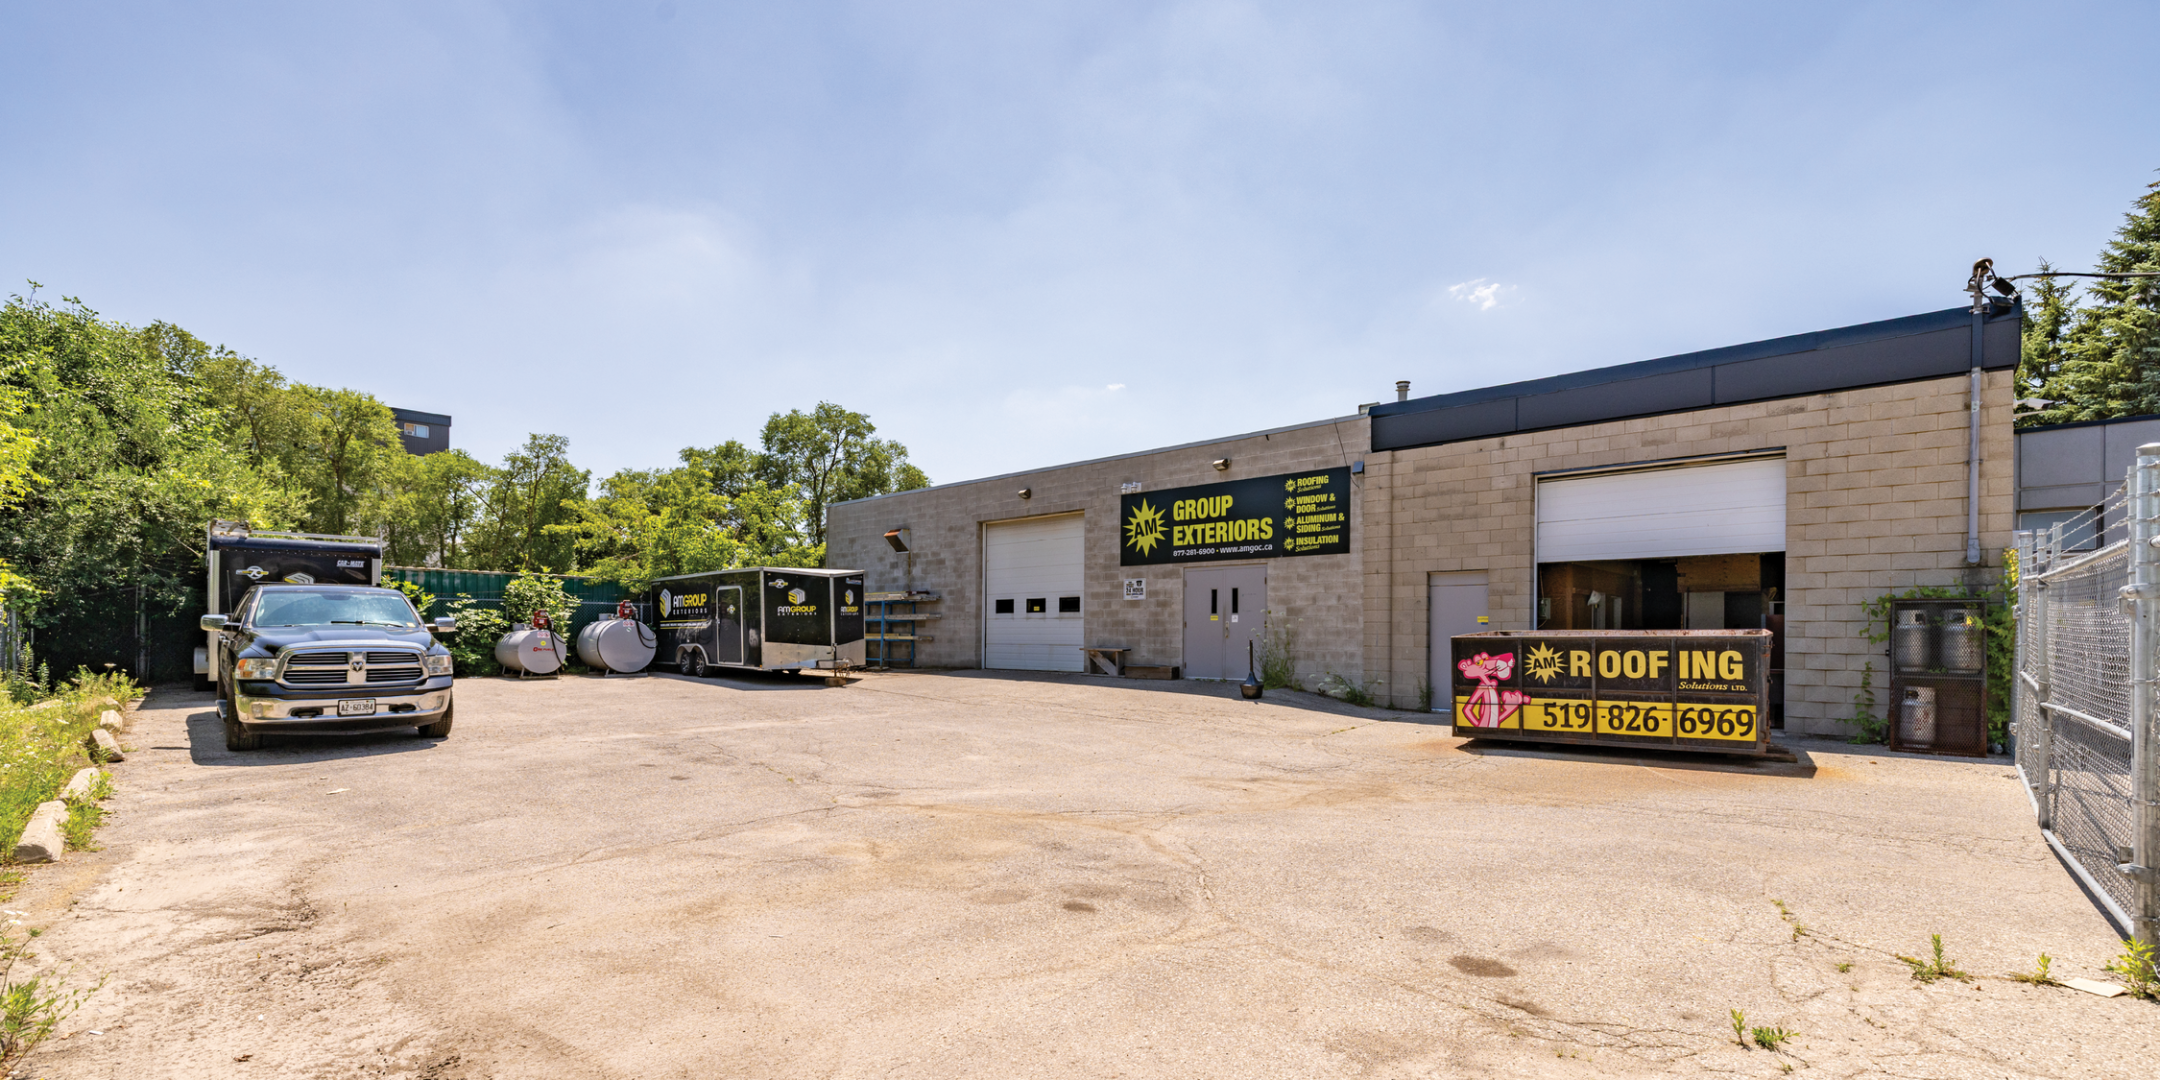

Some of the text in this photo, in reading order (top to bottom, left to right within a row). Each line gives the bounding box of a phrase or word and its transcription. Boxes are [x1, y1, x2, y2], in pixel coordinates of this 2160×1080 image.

[1297, 475, 1329, 487] ROOFING
[1296, 493, 1336, 505] WINDOW &
[1173, 494, 1233, 521] GROUP
[1296, 504, 1316, 514] DOOR
[1296, 512, 1345, 525] ALUMINUM &
[1134, 517, 1158, 539] AM
[1173, 517, 1273, 546] EXTERIORS
[1296, 523, 1321, 534] SIDING
[1296, 534, 1339, 546] INSULATION
[1173, 544, 1273, 557] 877-281-6900 www.amgoc.ca
[1532, 656, 1557, 669] AM
[1678, 681, 1728, 691] Solutions
